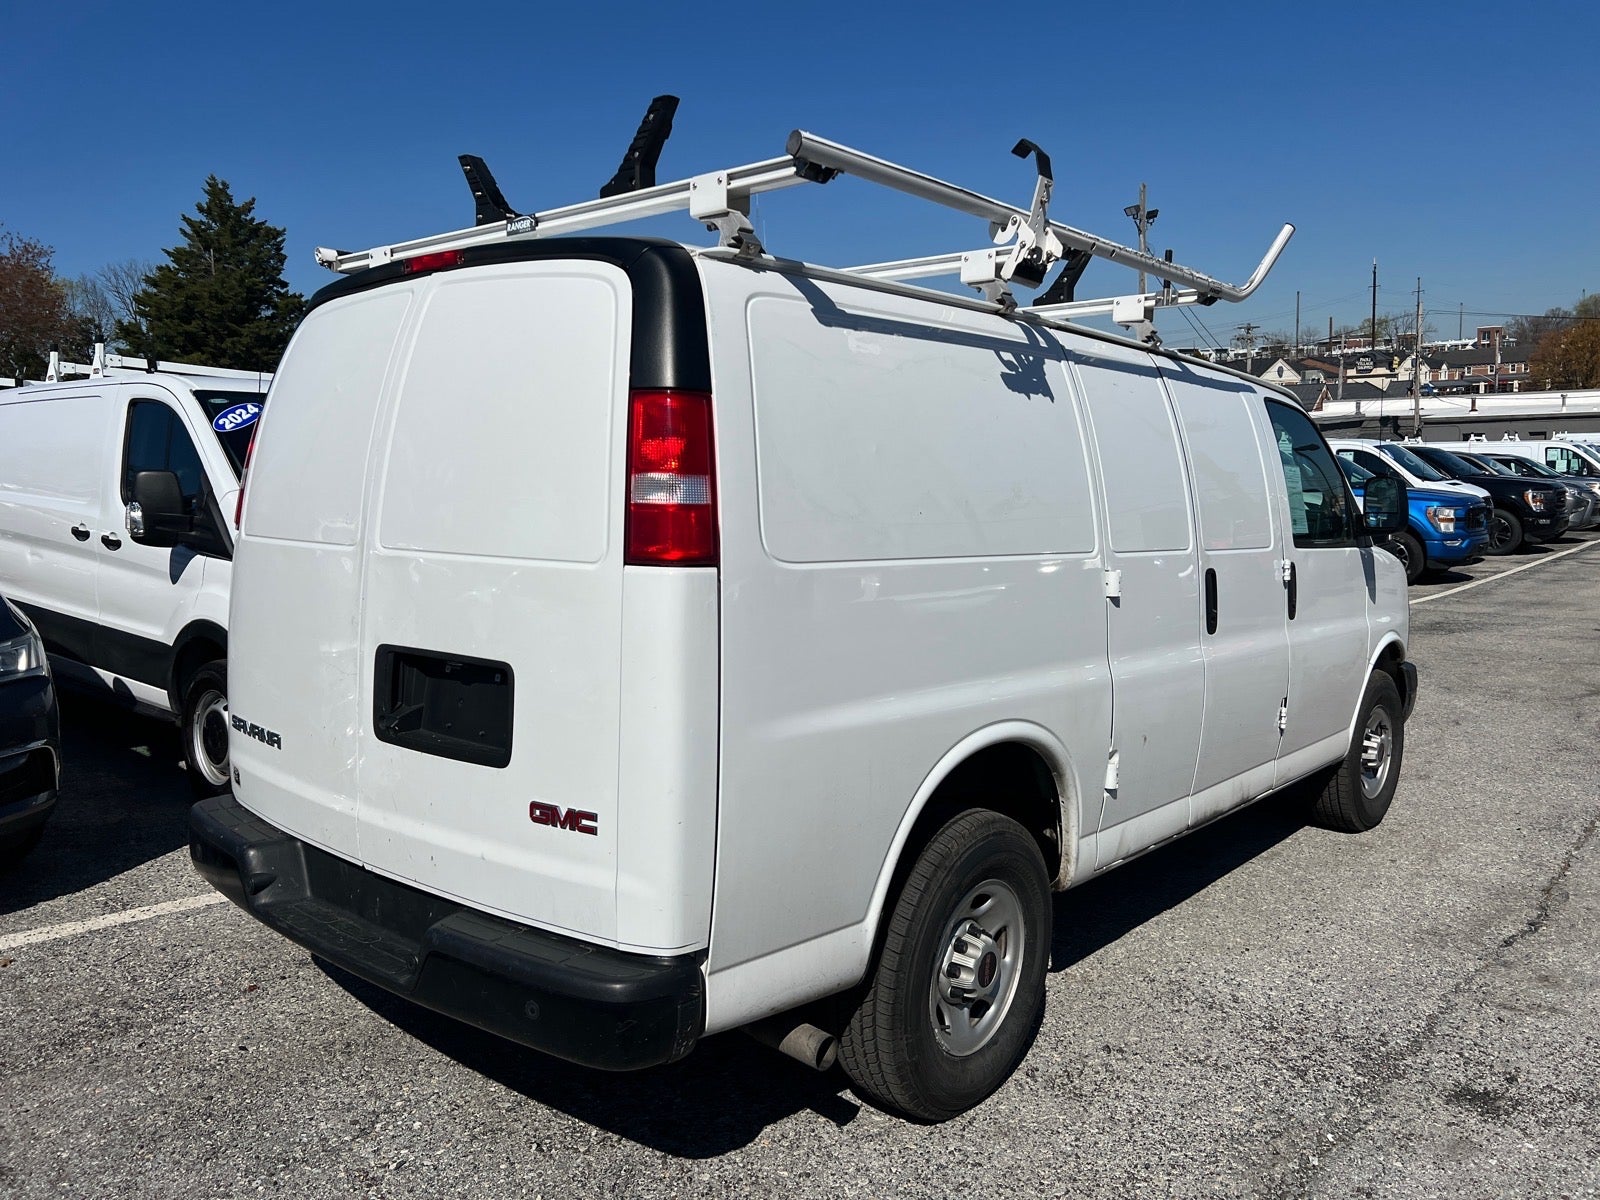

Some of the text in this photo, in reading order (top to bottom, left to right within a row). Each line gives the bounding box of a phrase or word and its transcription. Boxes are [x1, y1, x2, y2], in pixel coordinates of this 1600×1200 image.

[507, 219, 531, 232] RANGER
[218, 403, 260, 430] 2024
[231, 714, 282, 751] SAVANA
[529, 800, 598, 836] GMC
